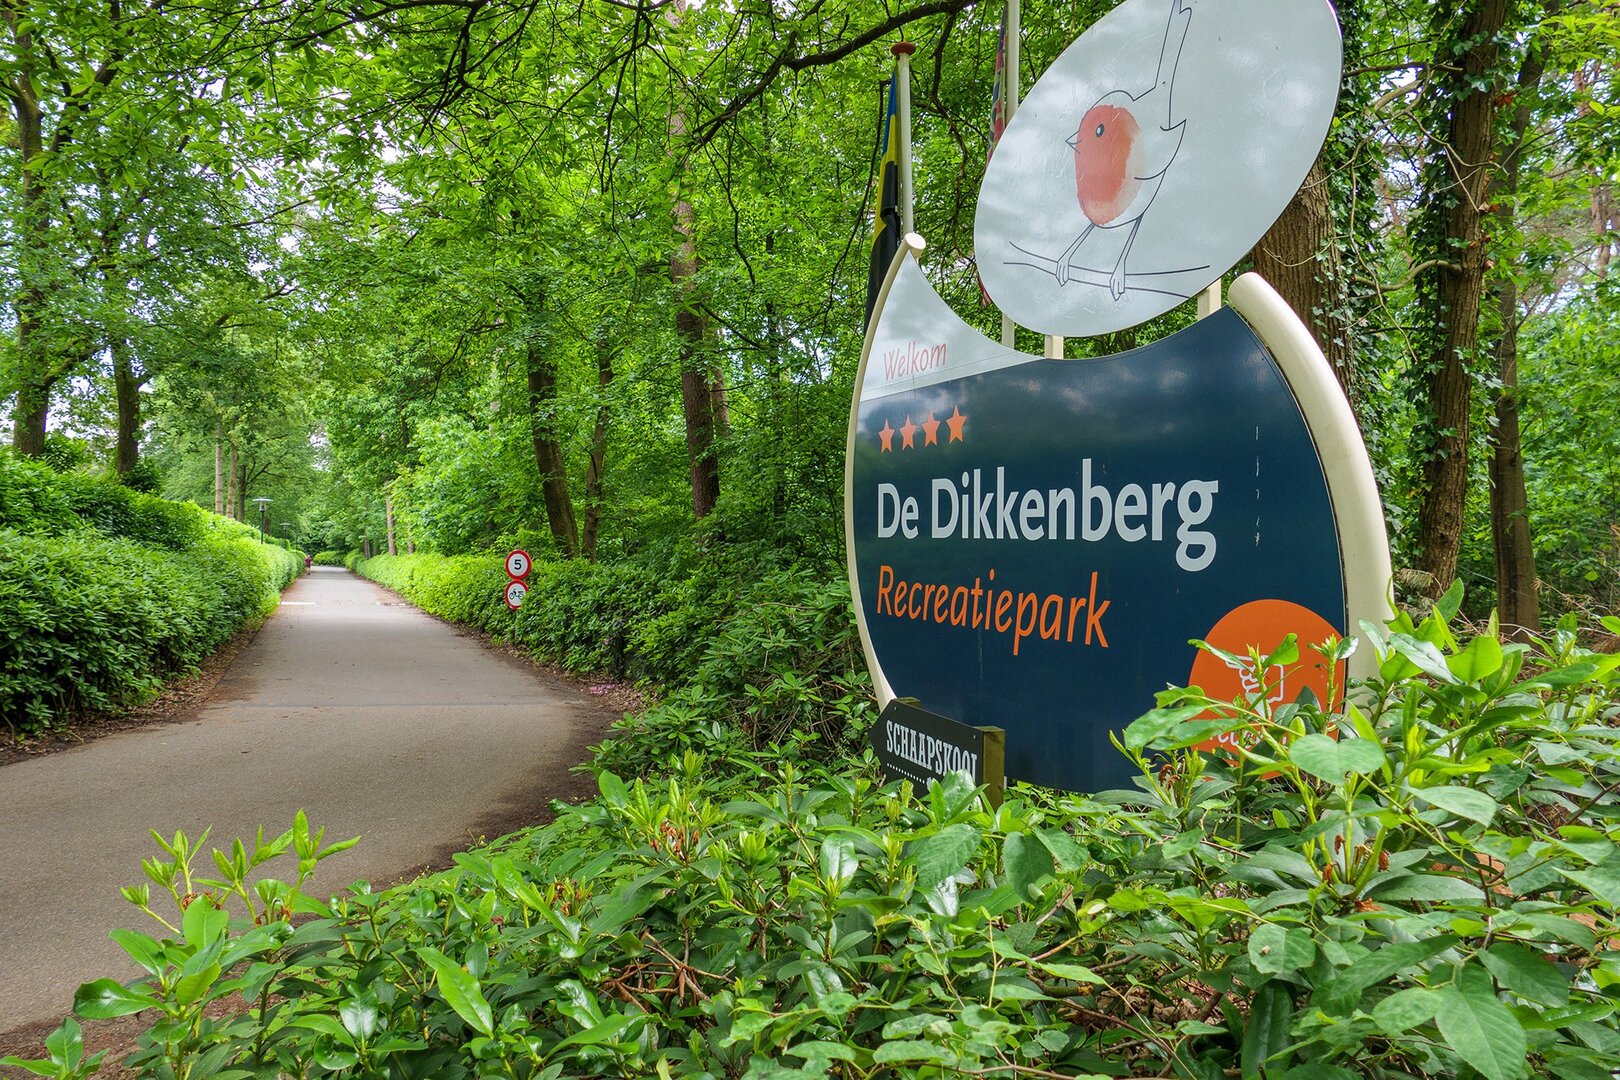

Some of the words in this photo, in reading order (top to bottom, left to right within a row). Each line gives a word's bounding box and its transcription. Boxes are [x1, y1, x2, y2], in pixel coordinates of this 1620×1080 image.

[884, 340, 947, 381] Welkom
[877, 482, 919, 539] De
[931, 458, 1219, 572] Dikkenberg
[514, 559, 522, 570] 5
[876, 565, 1111, 656] Recreatiepark
